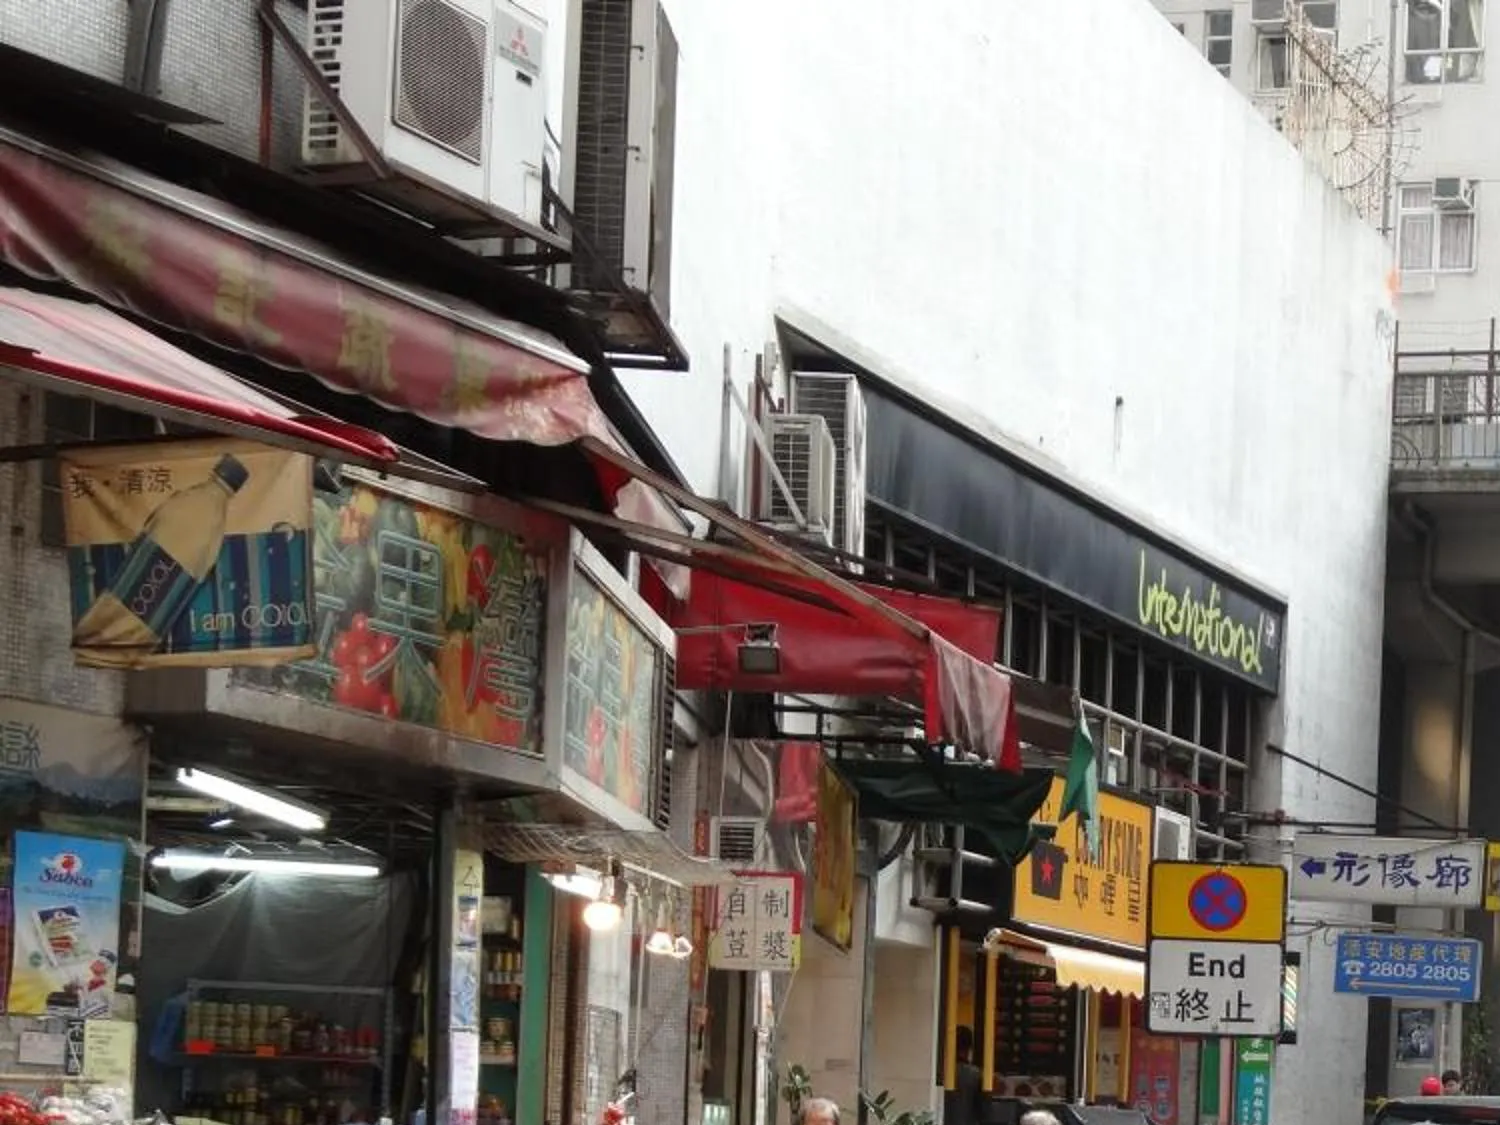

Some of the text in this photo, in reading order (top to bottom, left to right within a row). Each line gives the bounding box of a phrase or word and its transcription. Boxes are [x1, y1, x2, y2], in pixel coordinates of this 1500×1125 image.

[202, 613, 236, 632] am
[1138, 548, 1263, 675] International
[1332, 851, 1473, 895] 形像廊
[1187, 951, 1245, 979] End
[1369, 961, 1472, 981] 2805 2805
[1174, 987, 1256, 1023] 終止
